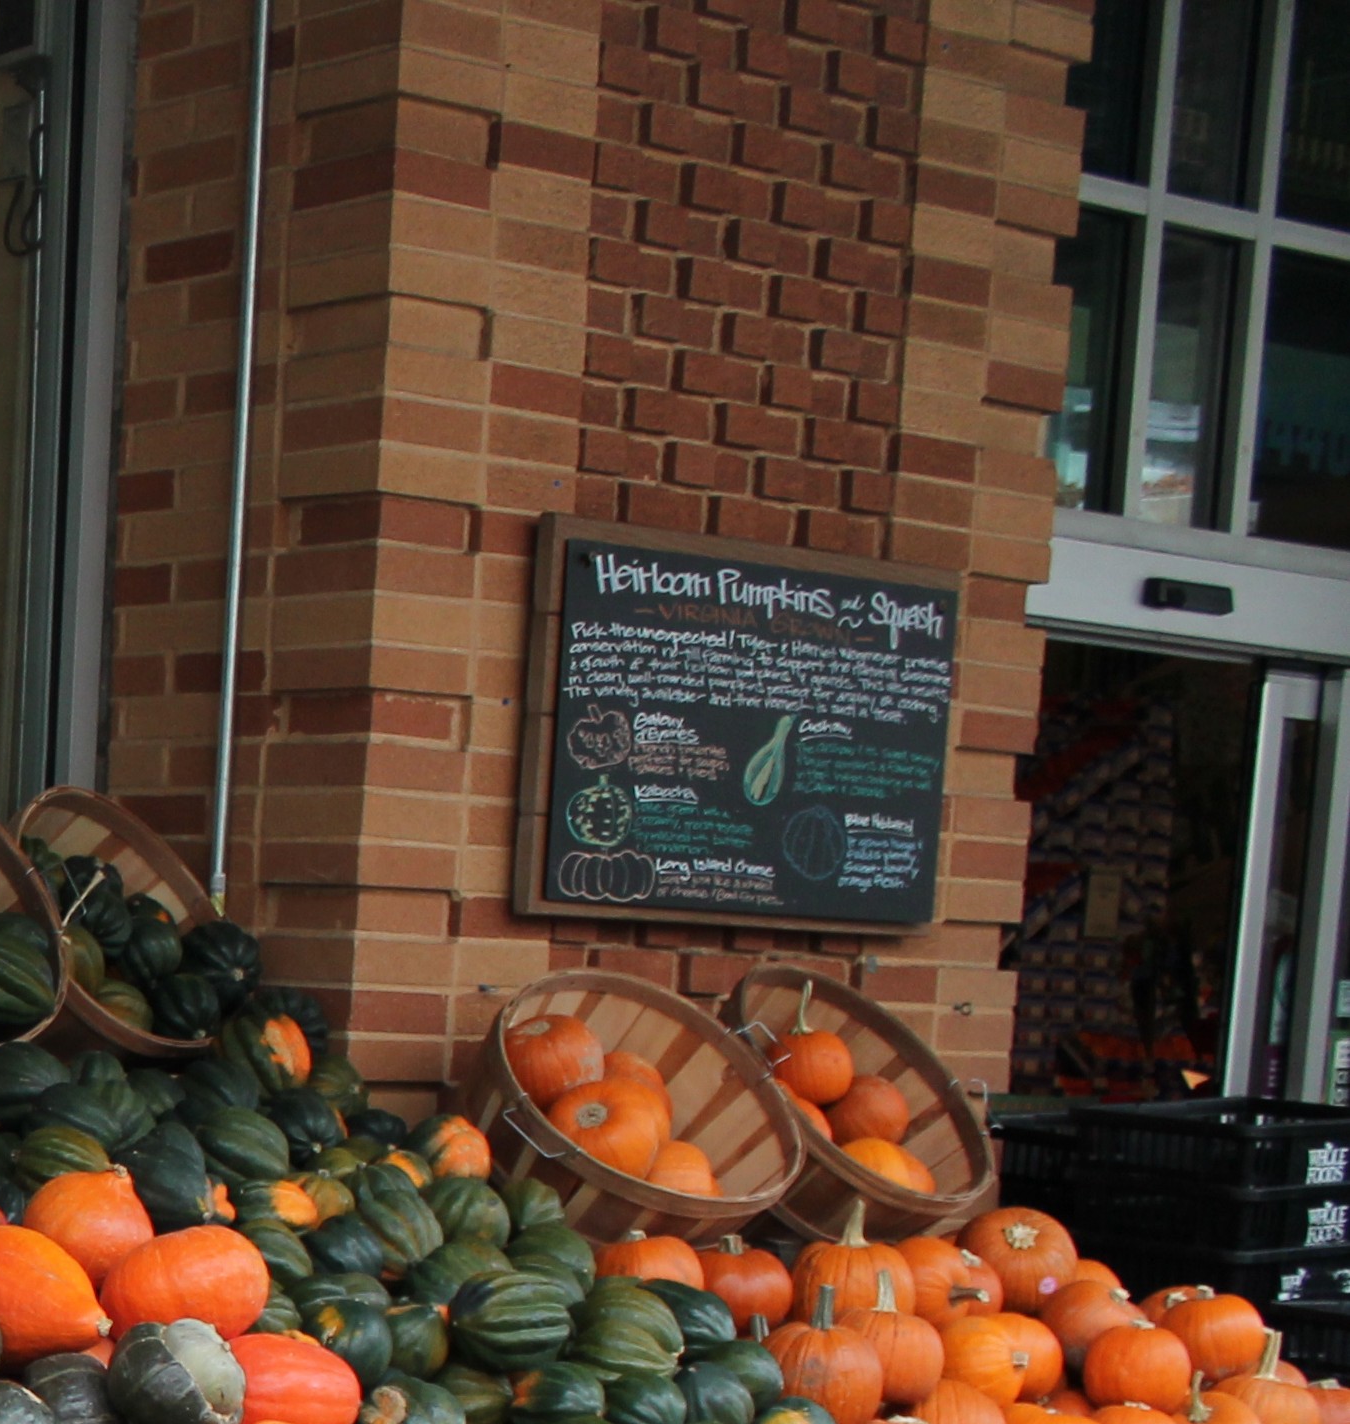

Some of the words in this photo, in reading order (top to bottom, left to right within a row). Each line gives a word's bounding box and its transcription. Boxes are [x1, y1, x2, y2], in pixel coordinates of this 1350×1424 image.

[595, 554, 712, 598] Heirloom
[717, 568, 836, 619] Pumpkins
[868, 591, 944, 650] Squash
